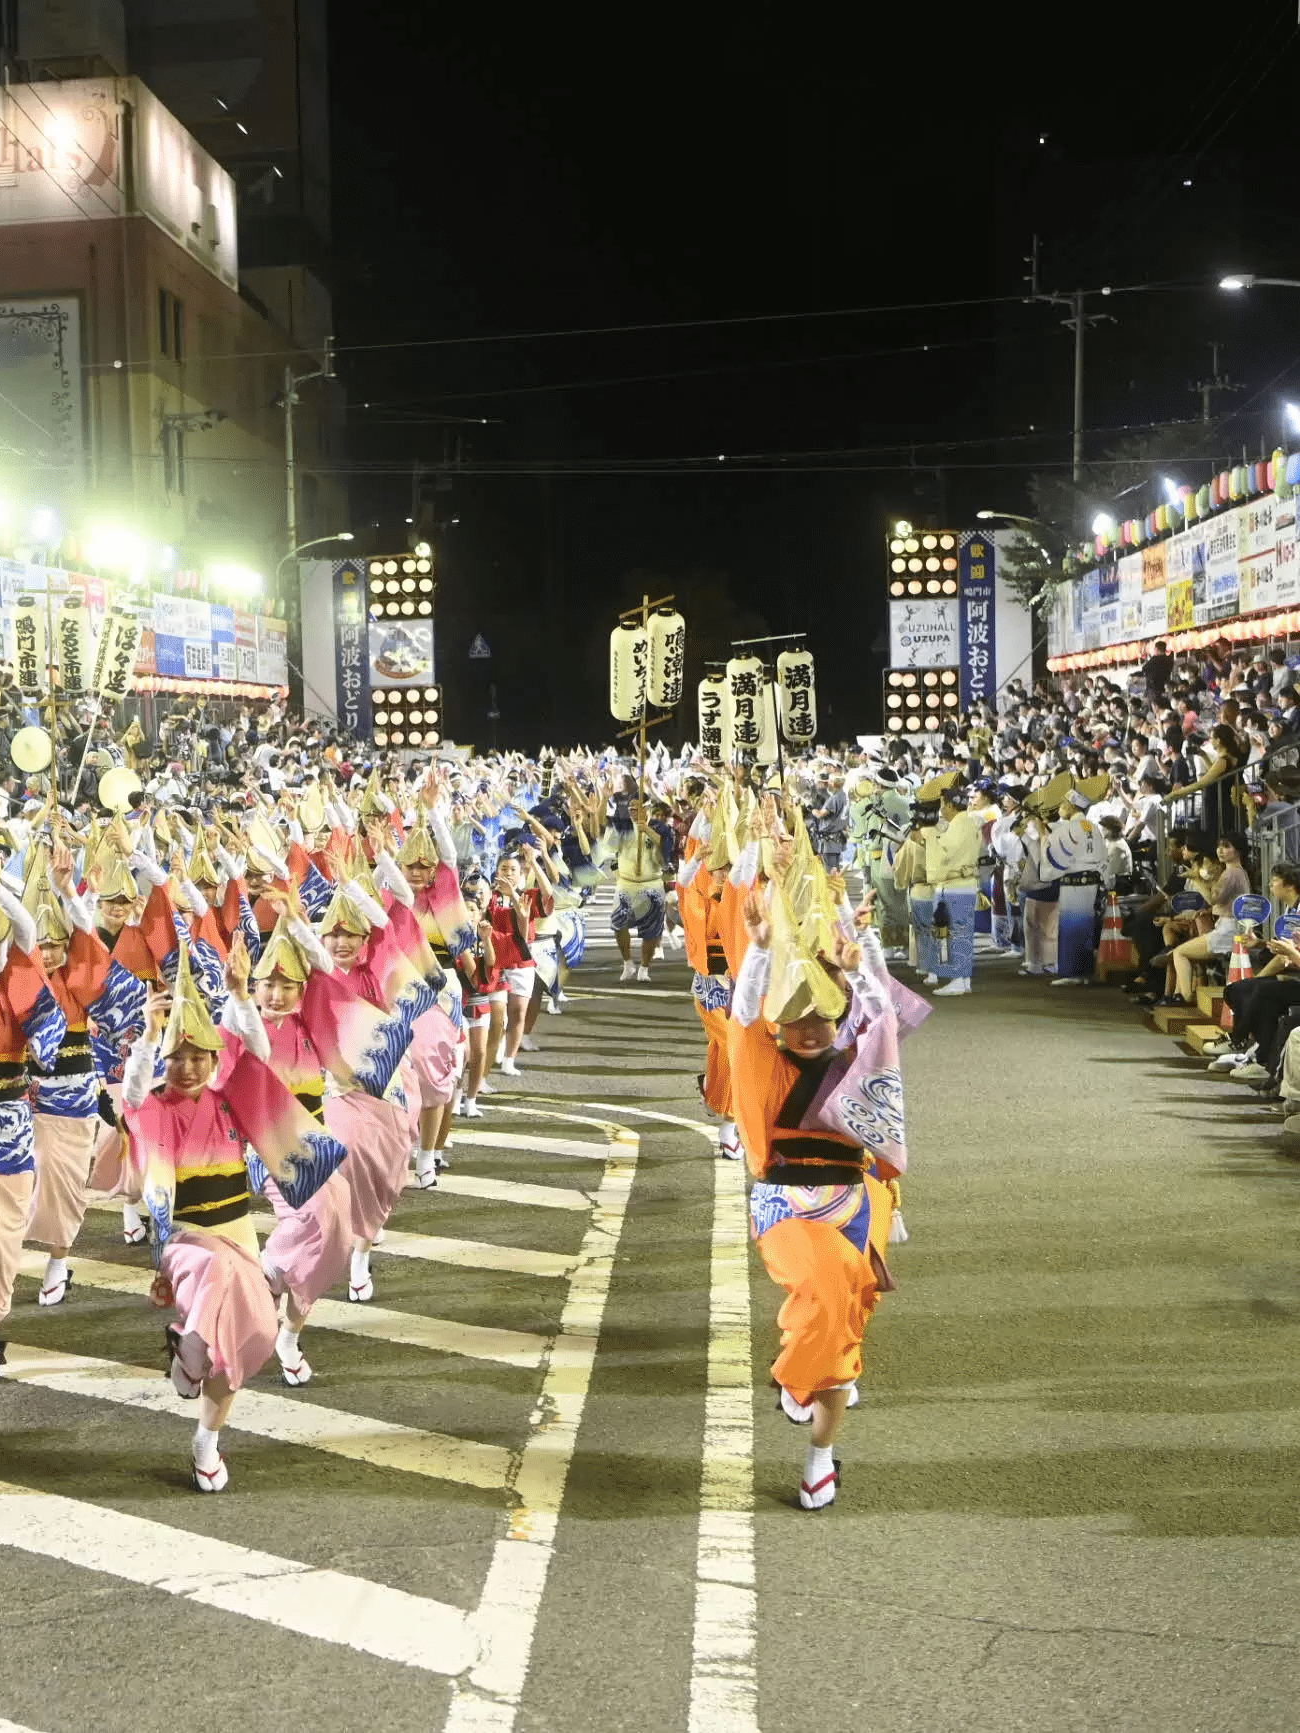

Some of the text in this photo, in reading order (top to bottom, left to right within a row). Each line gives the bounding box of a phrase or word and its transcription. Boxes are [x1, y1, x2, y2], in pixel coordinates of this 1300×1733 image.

[15, 615, 39, 687] 鳴門市連
[908, 623, 956, 633] UZUHALL
[913, 635, 950, 643] UZUPA
[341, 625, 362, 730] 阿波おどり
[731, 672, 760, 744] 満月連
[785, 664, 814, 736] 満月連
